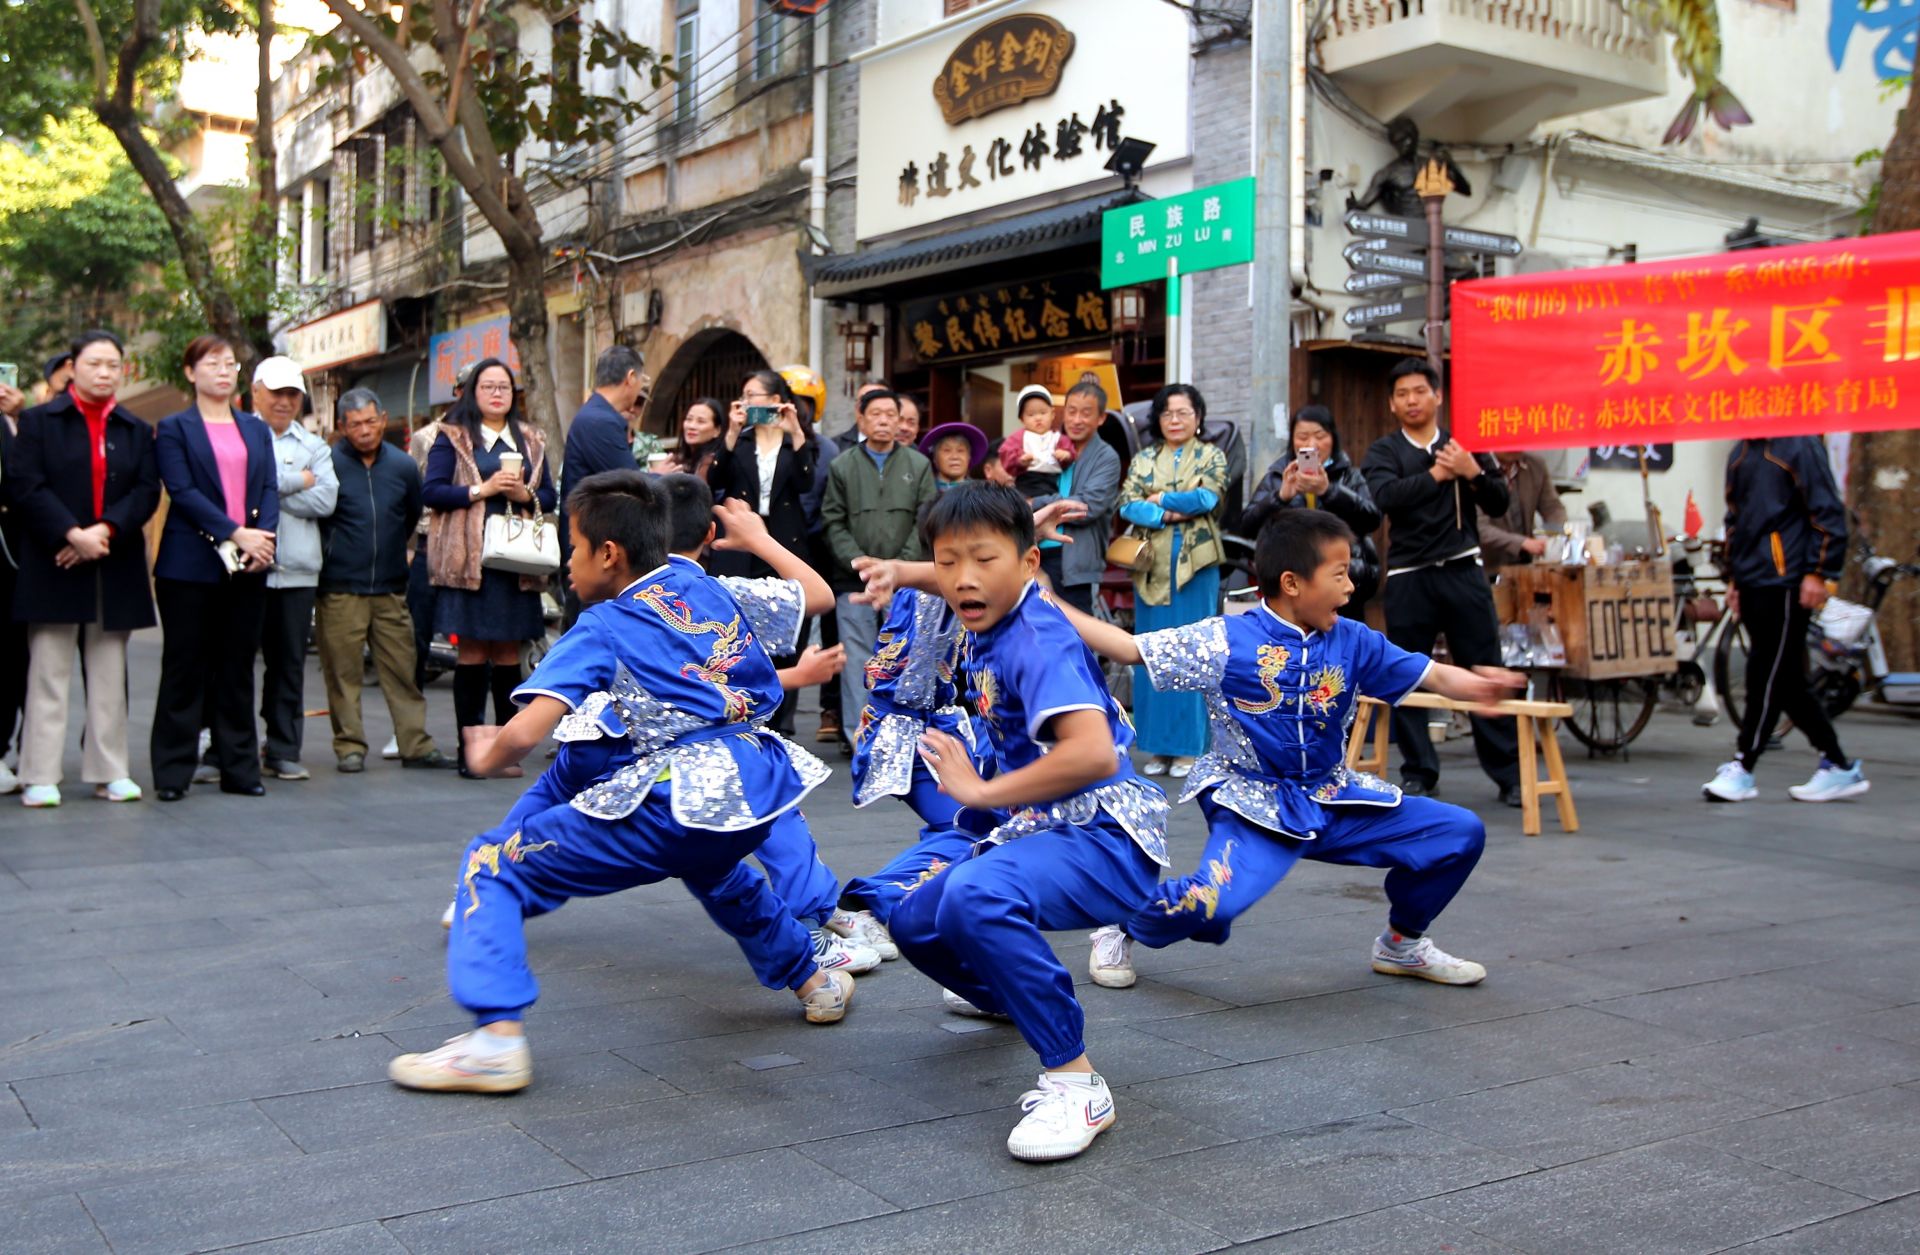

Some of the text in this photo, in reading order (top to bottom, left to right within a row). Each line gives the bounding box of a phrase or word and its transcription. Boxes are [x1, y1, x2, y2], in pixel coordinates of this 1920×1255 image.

[898, 99, 1124, 207] 非遗文化体验馆
[1129, 197, 1221, 239] 民族路
[1165, 233, 1182, 249] ZU
[1194, 227, 1211, 243] LU
[914, 291, 1108, 357] 黎民伟纪念馆
[1588, 597, 1674, 661] COFFEE
